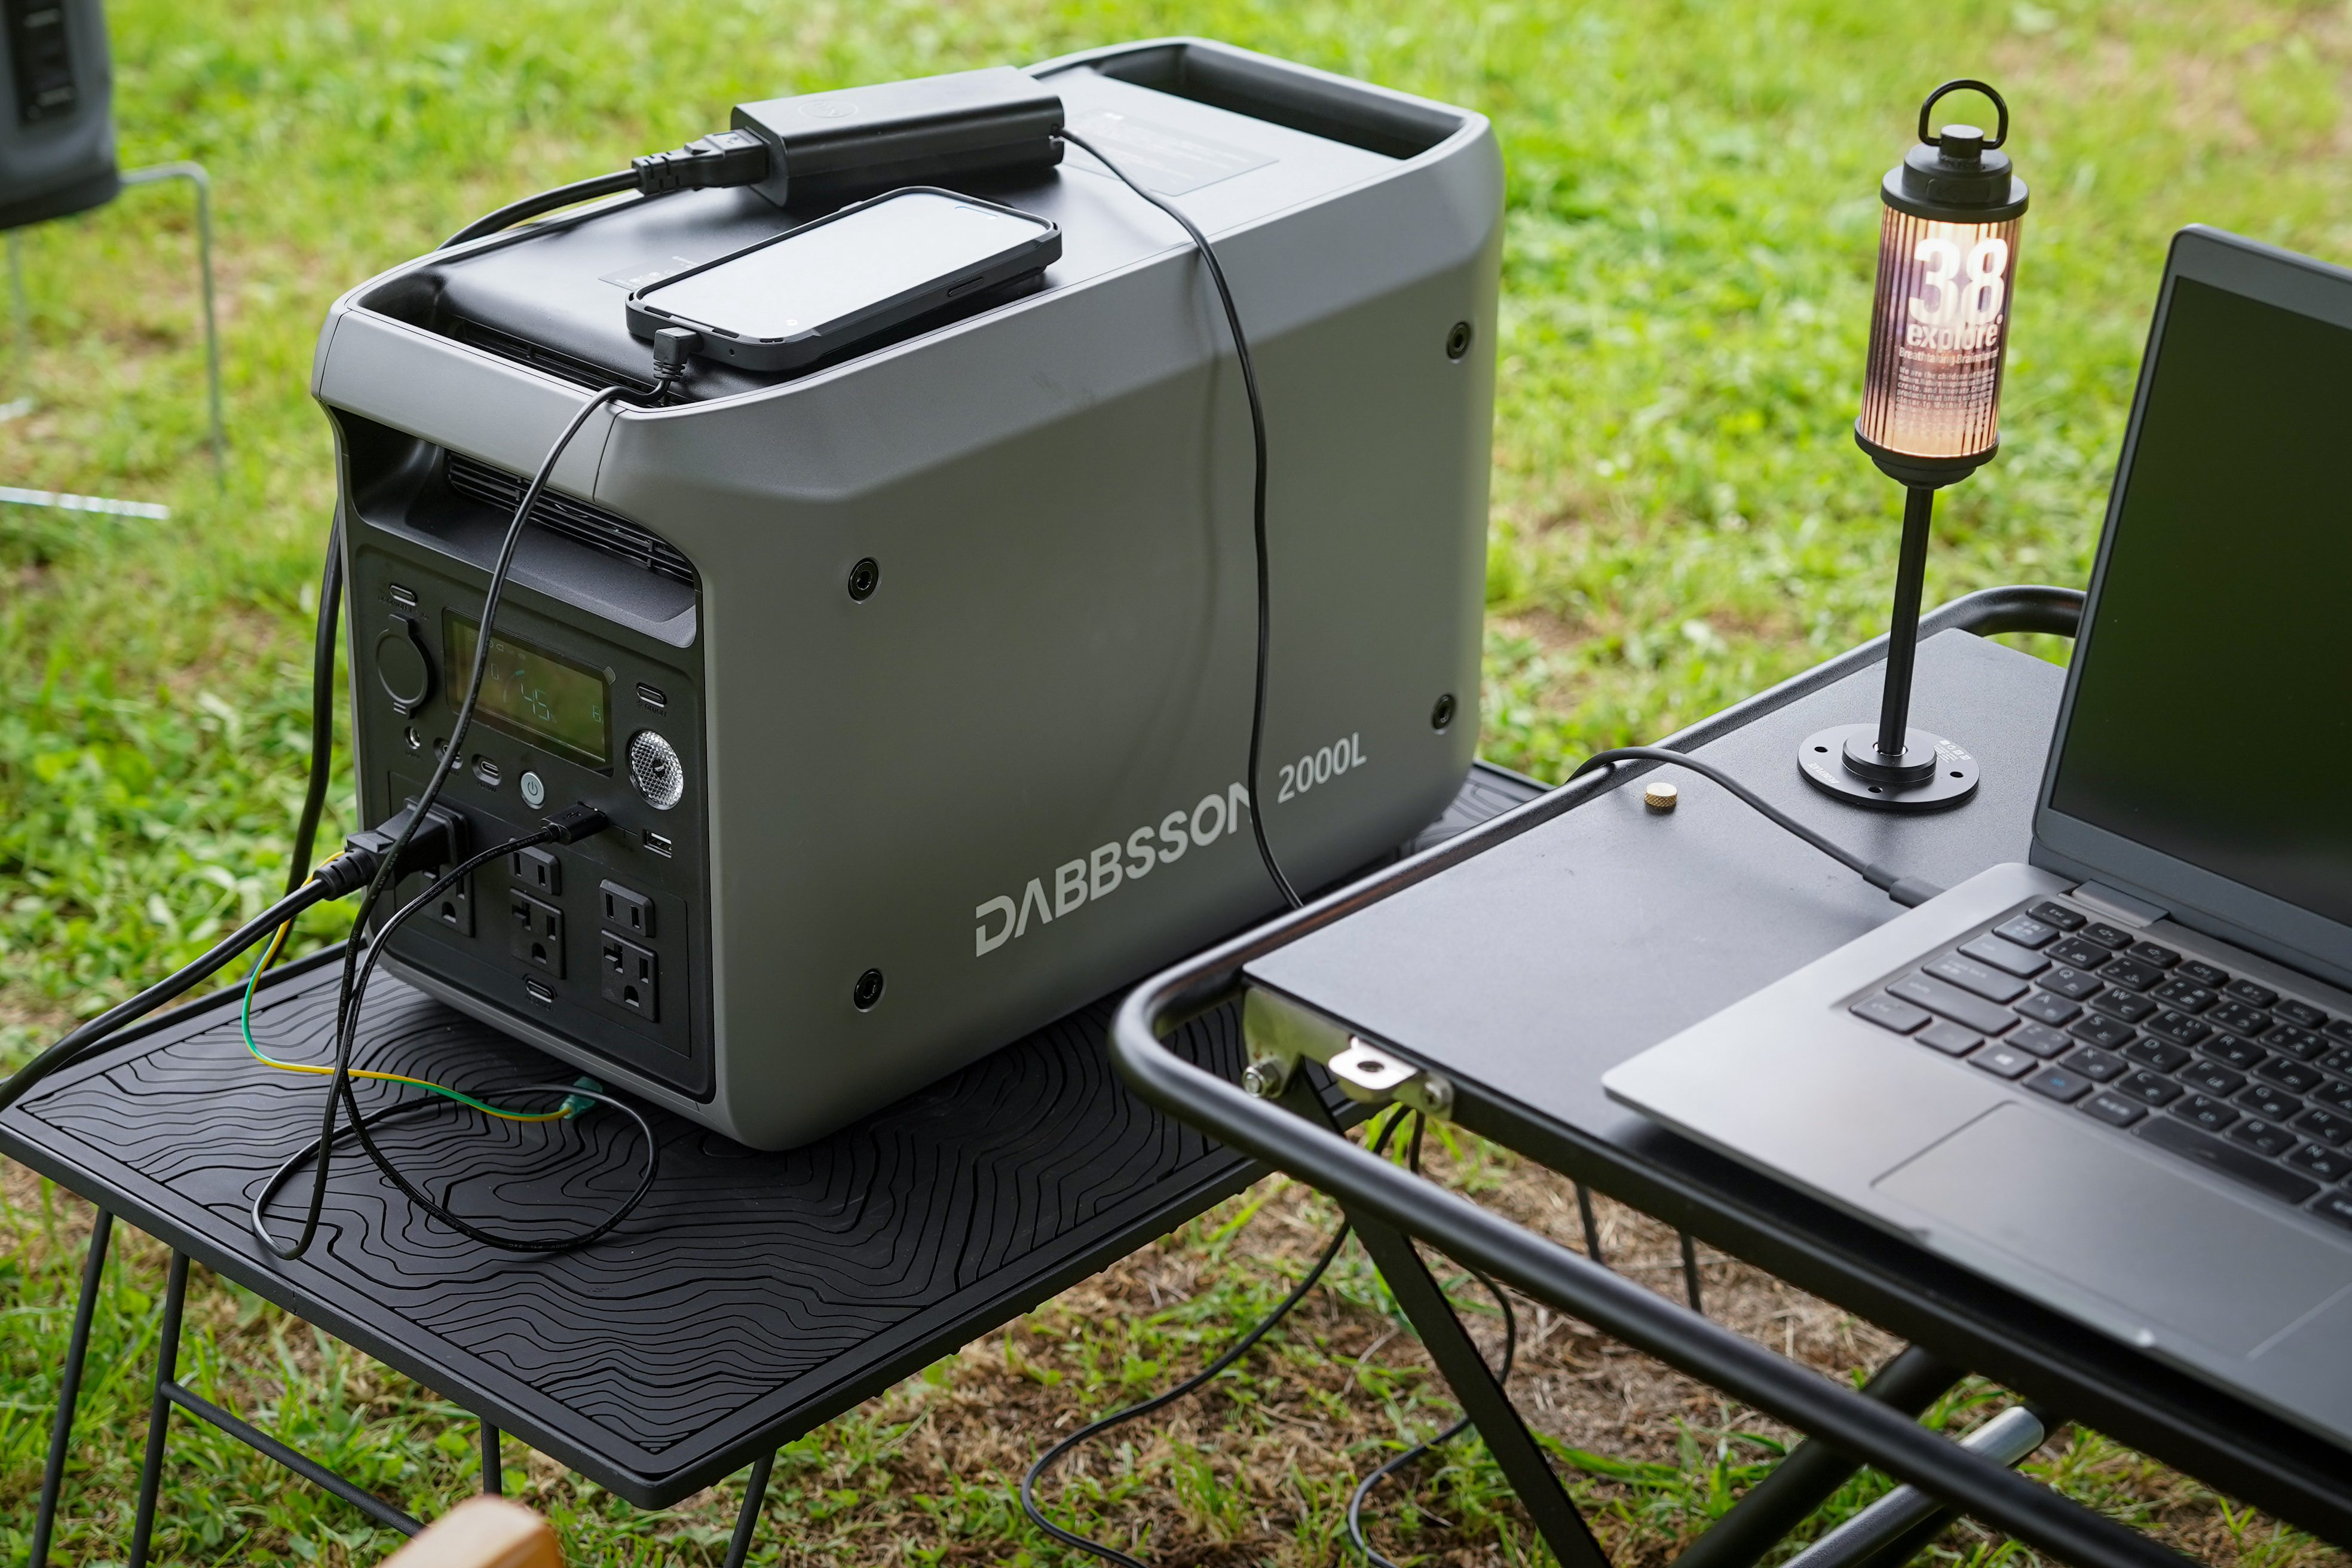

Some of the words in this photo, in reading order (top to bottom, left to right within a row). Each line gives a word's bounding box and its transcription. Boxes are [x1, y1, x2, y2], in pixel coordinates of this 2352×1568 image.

[1909, 238, 2008, 324] 38
[1277, 732, 1367, 804] 2000L
[2059, 969, 2075, 979] Q
[2035, 994, 2051, 1005] A
[2111, 988, 2132, 1001] W
[2088, 1015, 2106, 1027] S
[2164, 1011, 2181, 1022] E
[2026, 1025, 2044, 1036] Z
[2143, 1037, 2161, 1049] D
[2219, 1033, 2236, 1047] R
[2197, 1061, 2216, 1071] F
[2278, 1059, 2294, 1069] T
[2136, 1070, 2155, 1083] C
[2255, 1086, 2274, 1098] G
[2334, 1083, 2350, 1094] Y
[2194, 1096, 2212, 1107] V
[2311, 1110, 2331, 1124] H
[2304, 1143, 2327, 1159] N
